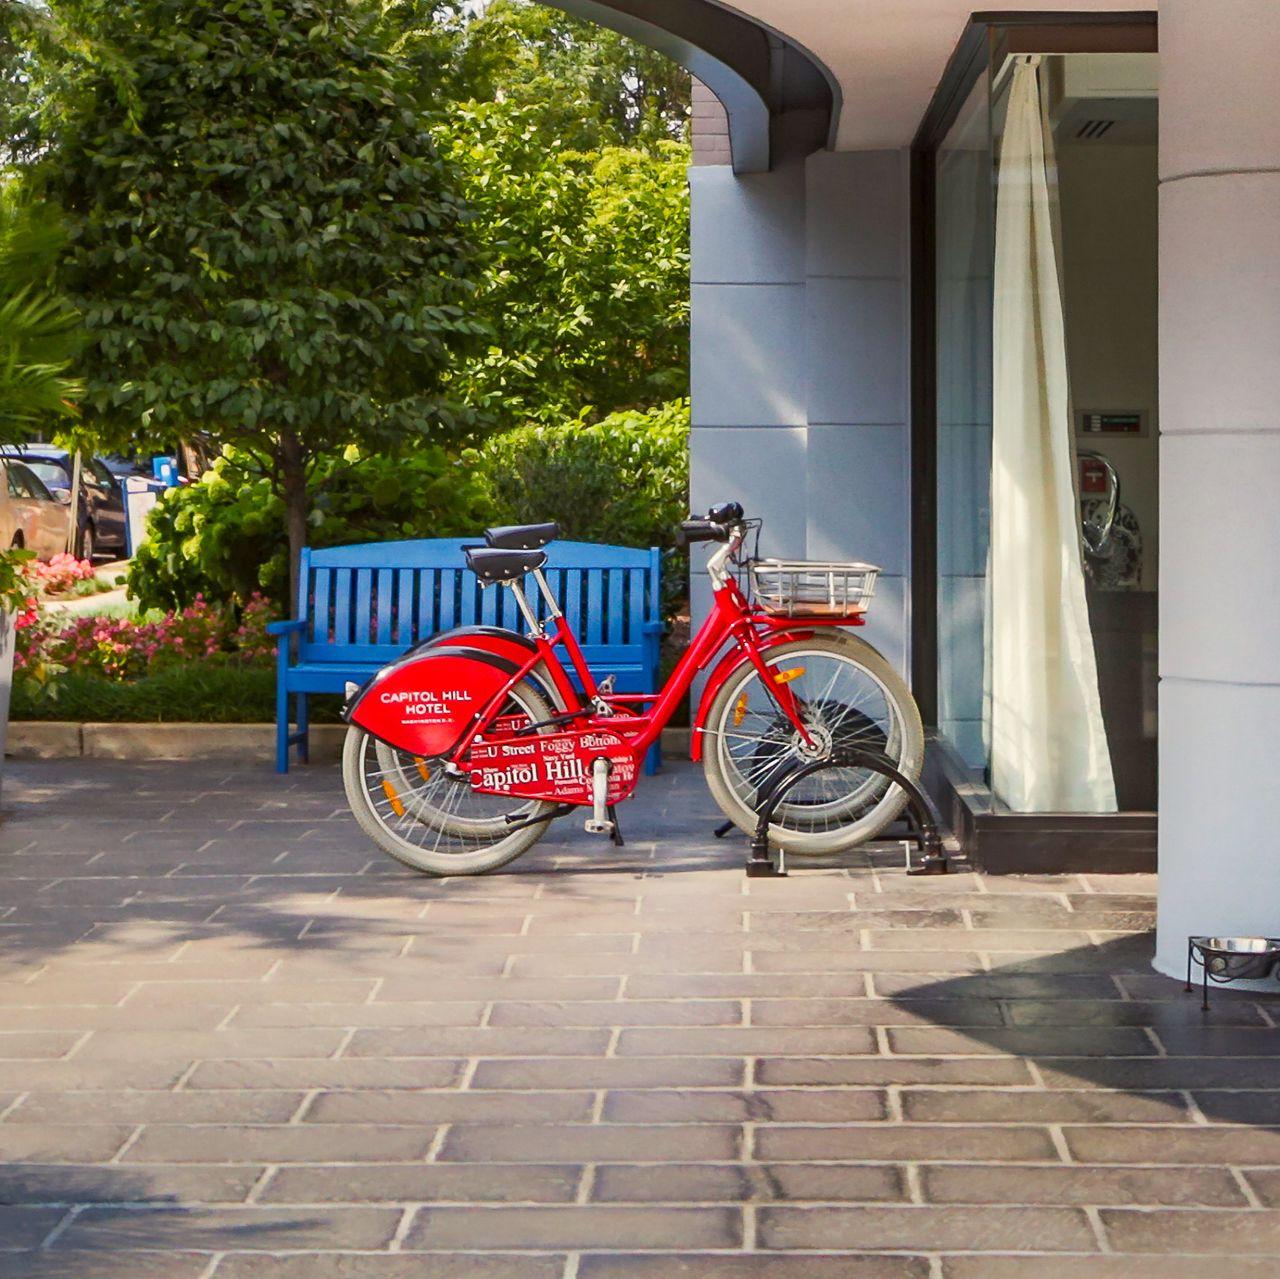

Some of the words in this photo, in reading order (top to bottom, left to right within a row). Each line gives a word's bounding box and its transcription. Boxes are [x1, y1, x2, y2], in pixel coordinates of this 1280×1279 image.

[380, 692, 438, 704] CAPITOL
[442, 690, 472, 701] HILL
[405, 704, 451, 715] HOTEL
[487, 746, 498, 758] U
[501, 745, 535, 757] Street
[540, 739, 575, 753] Foggy
[471, 763, 538, 791] Capitol
[545, 758, 583, 781] Hill
